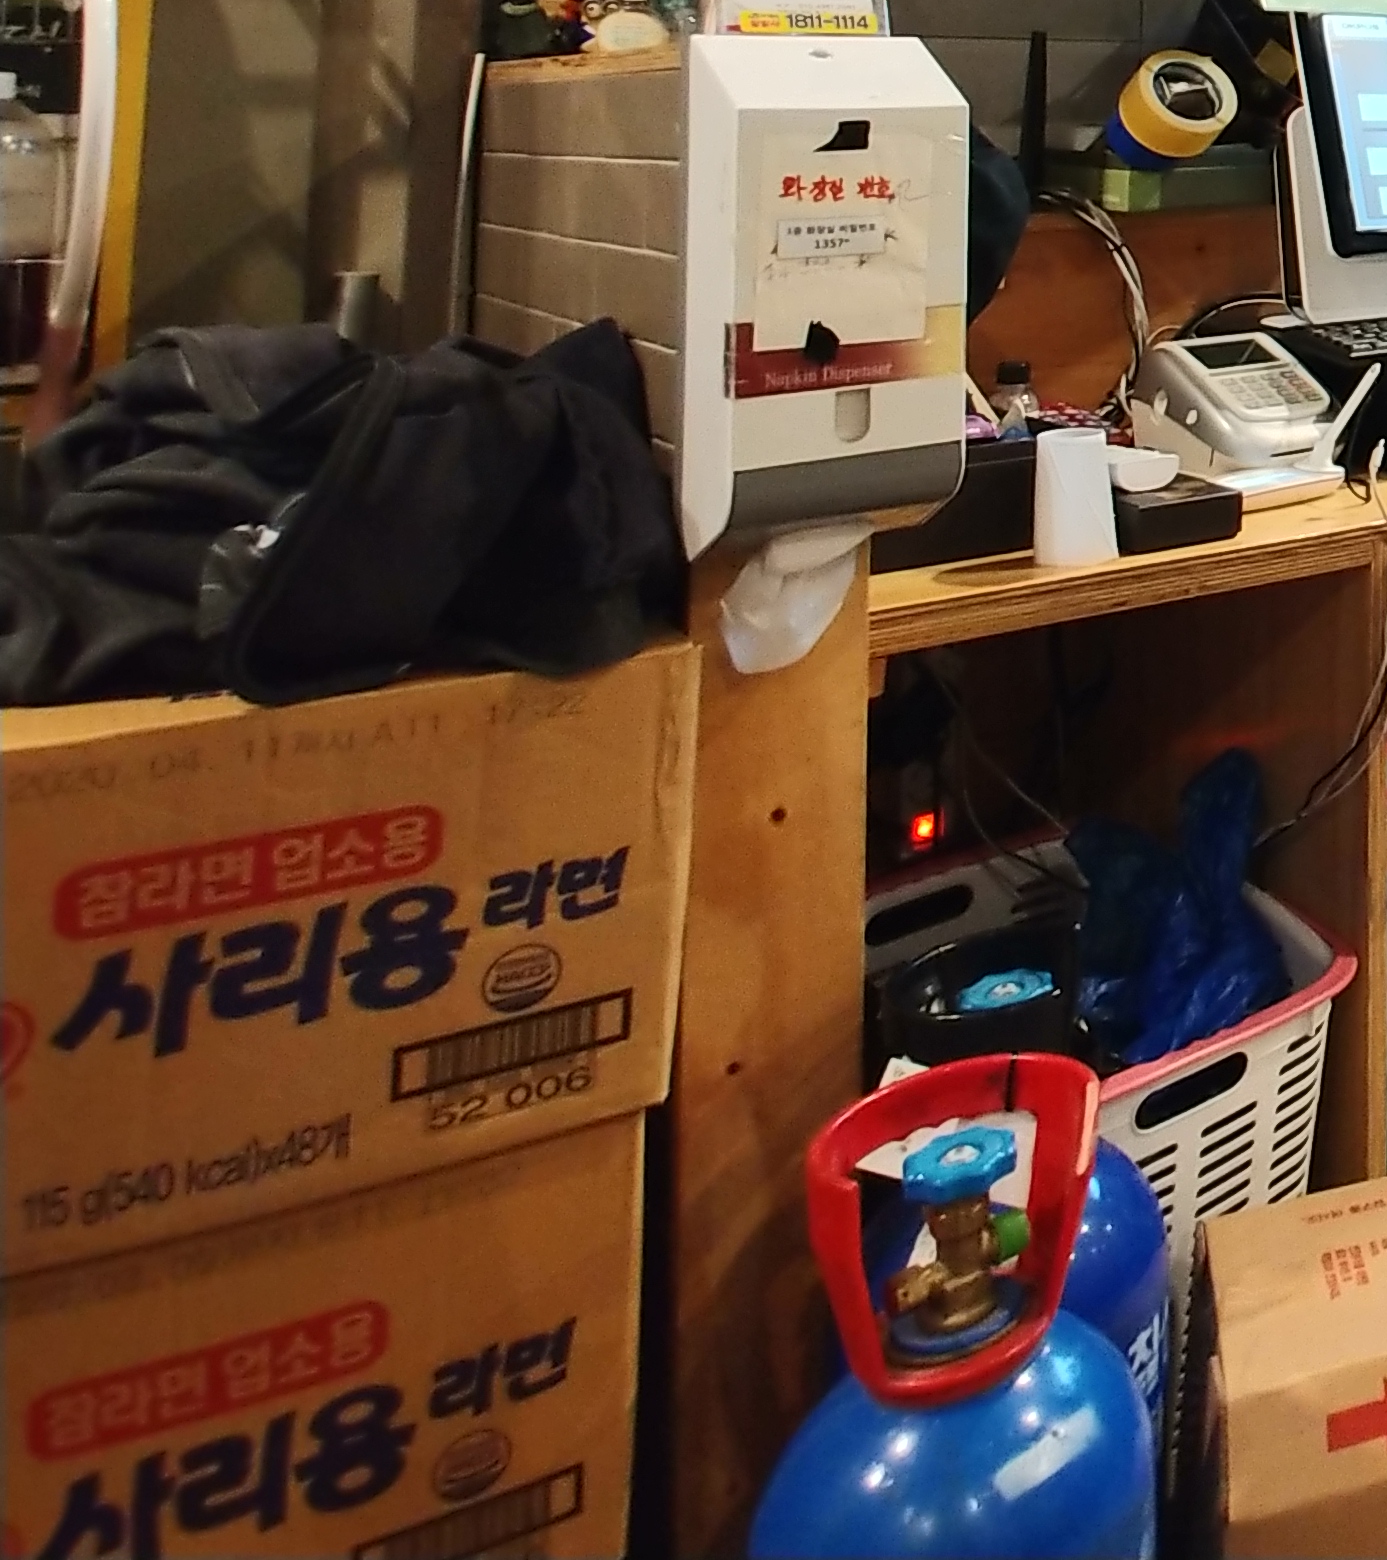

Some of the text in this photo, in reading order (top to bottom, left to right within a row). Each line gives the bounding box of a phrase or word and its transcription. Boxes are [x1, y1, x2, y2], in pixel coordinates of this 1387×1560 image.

[785, 13, 869, 30] 1811-1114
[764, 361, 894, 389] Napkin Dispenser
[77, 810, 430, 930] 참라면 업소용
[52, 843, 633, 1060] 사리용 라면
[428, 1064, 595, 1132] 52 006
[20, 1186, 72, 1230] 115
[220, 1309, 377, 1403] 업소용
[38, 1316, 579, 1560] 사리용 라면
